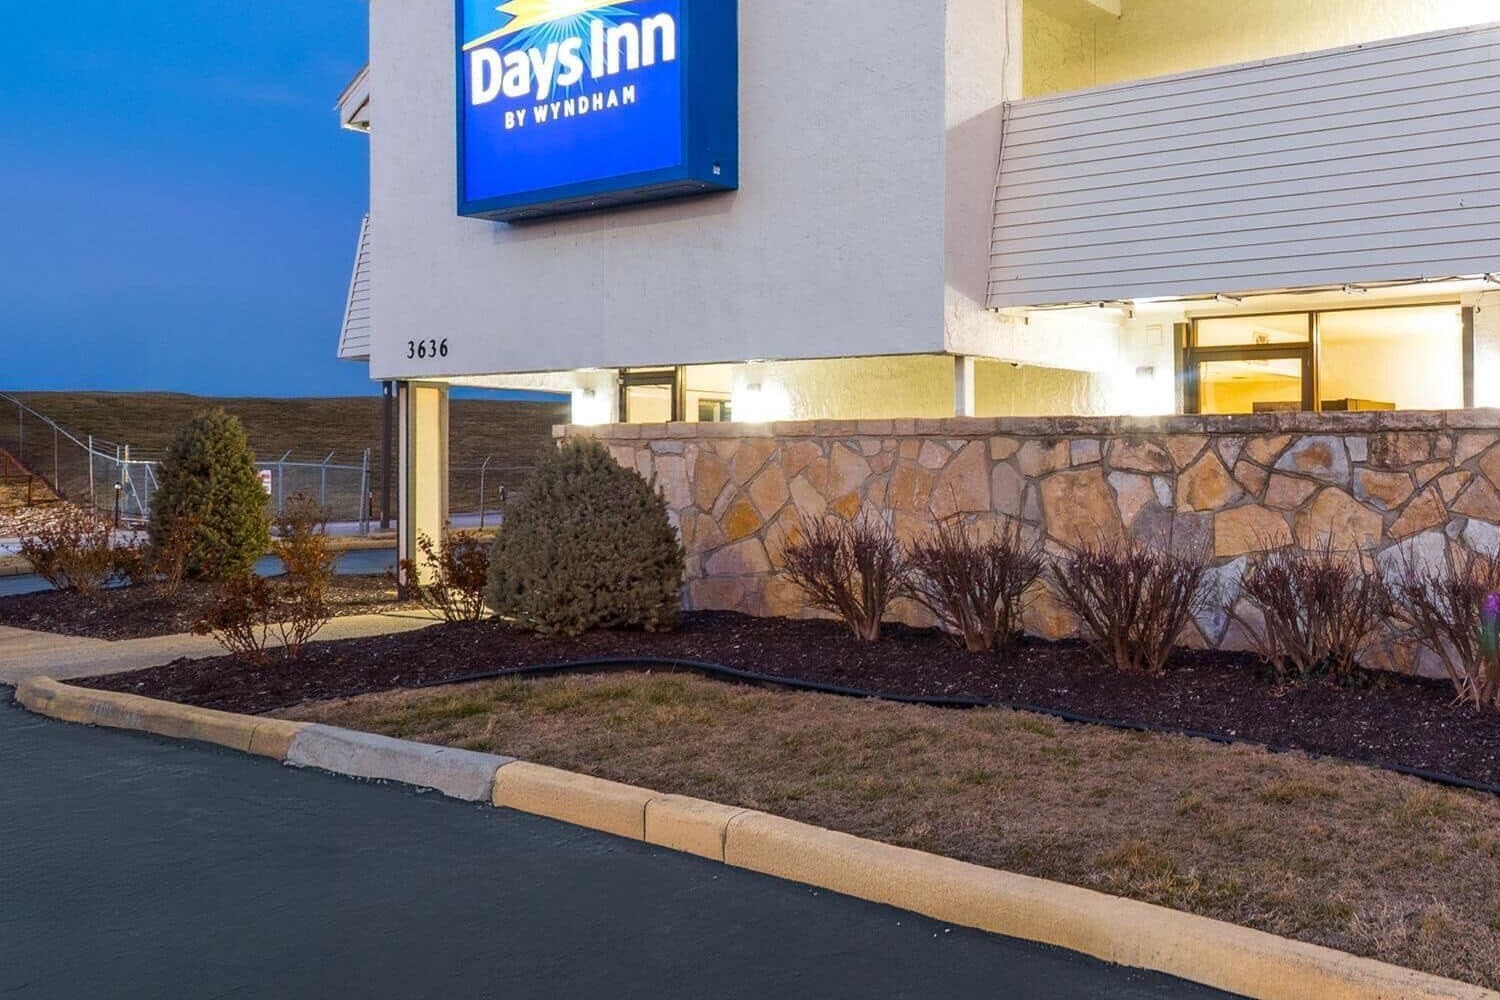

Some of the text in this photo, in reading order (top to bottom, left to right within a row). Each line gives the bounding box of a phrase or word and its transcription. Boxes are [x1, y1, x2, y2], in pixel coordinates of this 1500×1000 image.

[471, 12, 676, 106] Days Inn
[504, 85, 636, 130] BY WYNDHAM
[406, 337, 449, 360] 3636
